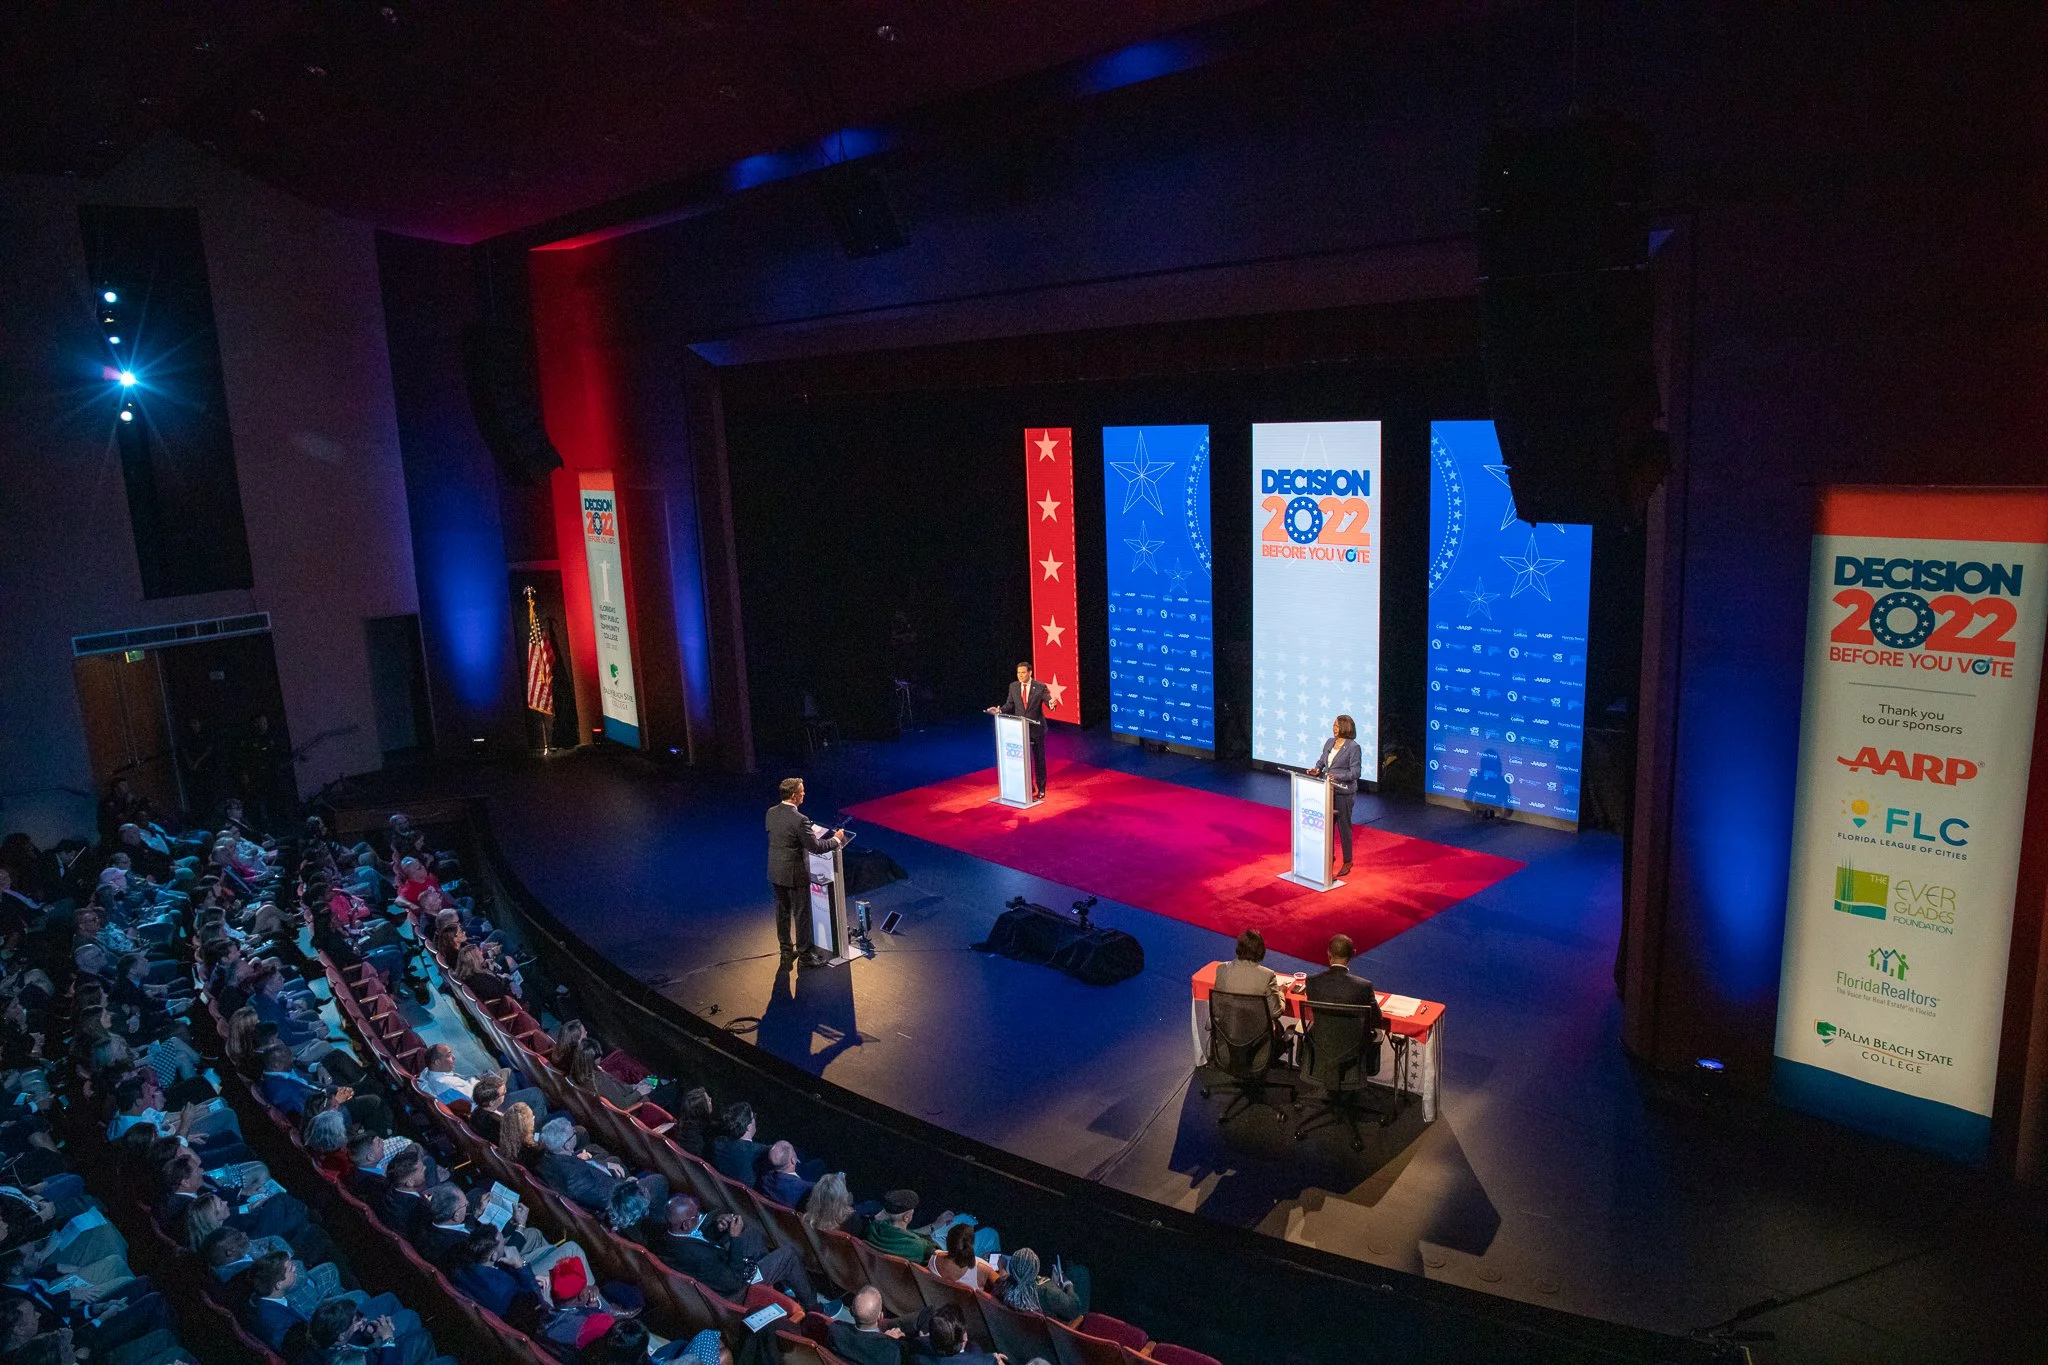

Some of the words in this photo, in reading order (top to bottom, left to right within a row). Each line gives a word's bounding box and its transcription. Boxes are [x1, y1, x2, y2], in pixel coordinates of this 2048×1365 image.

[1262, 469, 1370, 496] DECISION
[584, 498, 612, 512] DECISION
[585, 511, 614, 536] 2022
[1262, 495, 1370, 546] 2022
[1262, 545, 1306, 559] BEFORE
[1309, 547, 1334, 561] YOU
[1337, 548, 1370, 563] VOTE
[1834, 555, 2023, 596] DECISION
[1831, 588, 2017, 658] 2022
[1829, 647, 1904, 667] BEFORE
[1909, 653, 1952, 672] YOU
[1957, 657, 2013, 678] VOTE
[1862, 714, 1875, 725] to
[1877, 717, 1900, 727] our
[1902, 719, 1963, 735] sponsors
[1878, 703, 1917, 717] Thank
[1919, 709, 1944, 721] you
[1885, 807, 1970, 847] FLC
[1837, 831, 1876, 844] FLORIDA
[1880, 839, 1916, 851] LEAGUE
[1920, 846, 1932, 854] OF
[1935, 849, 1967, 860] CITIES
[1869, 874, 1888, 885] THE
[1893, 879, 1956, 910] EVER
[1893, 915, 1953, 935] FOUNDATION
[1894, 901, 1954, 925] GLADES
[1872, 997, 1886, 1005] Real
[1915, 1007, 1936, 1018] Florida
[1838, 1028, 1870, 1046] PALM
[1873, 1038, 1914, 1058] BEACH
[1917, 1050, 1953, 1067] STATE
[1861, 1051, 1922, 1074] COLLEGE
